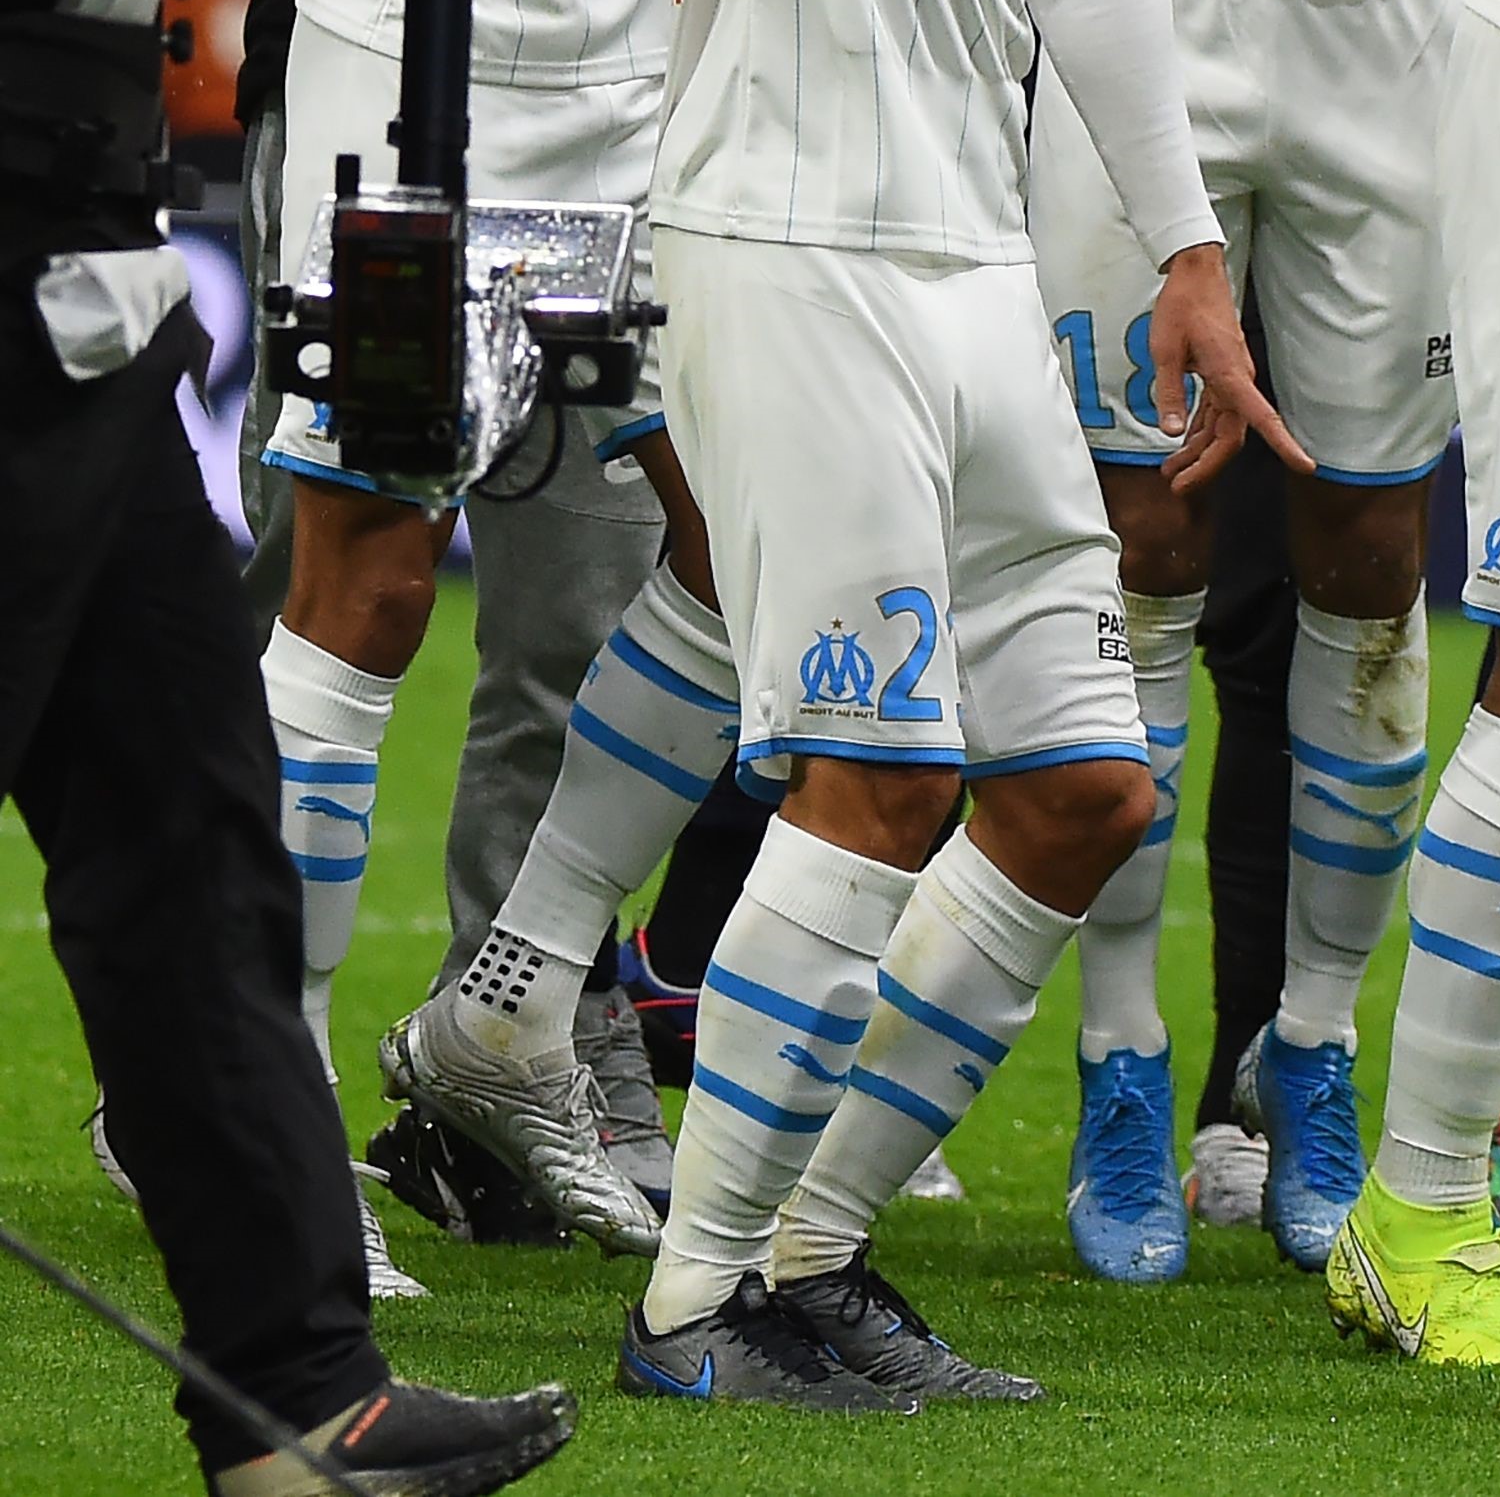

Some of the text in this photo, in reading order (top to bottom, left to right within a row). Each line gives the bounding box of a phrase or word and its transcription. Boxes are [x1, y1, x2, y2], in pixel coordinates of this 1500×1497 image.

[799, 707, 876, 720] DROIT AU BUT
